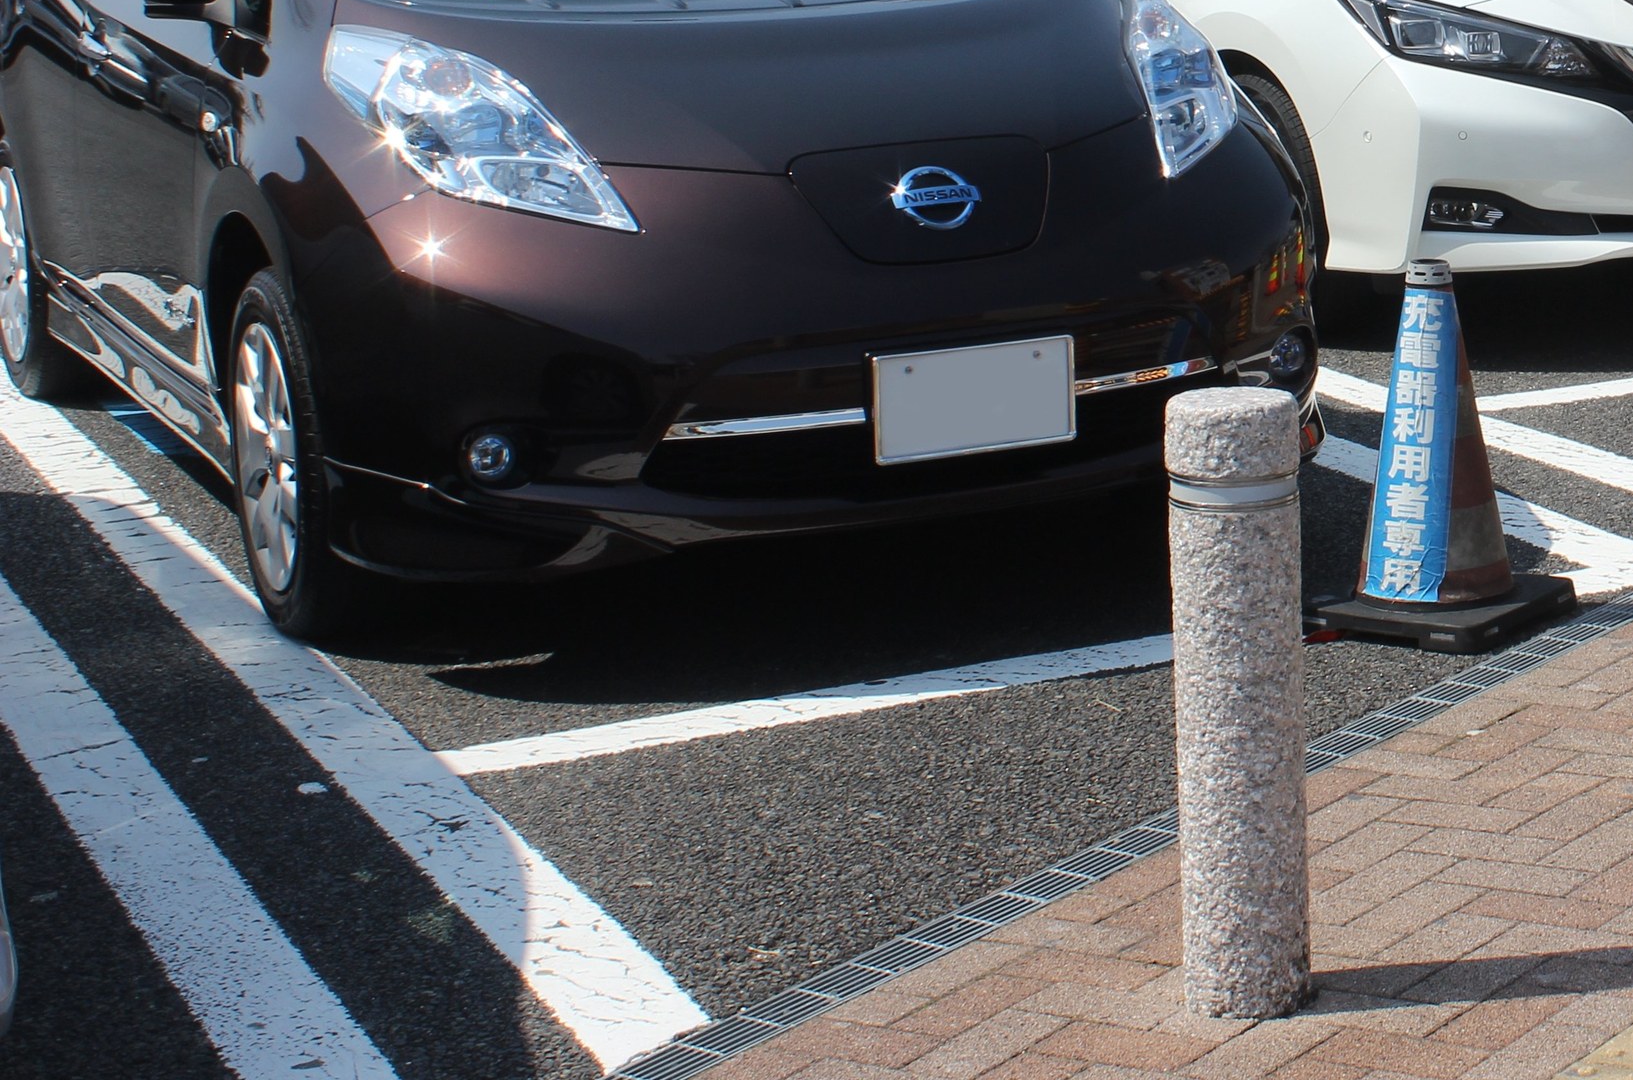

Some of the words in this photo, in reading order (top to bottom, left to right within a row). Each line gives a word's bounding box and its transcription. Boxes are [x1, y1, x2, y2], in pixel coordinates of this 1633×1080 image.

[904, 188, 973, 204] NISSAN
[1380, 294, 1444, 596] 充電器利用者専用
